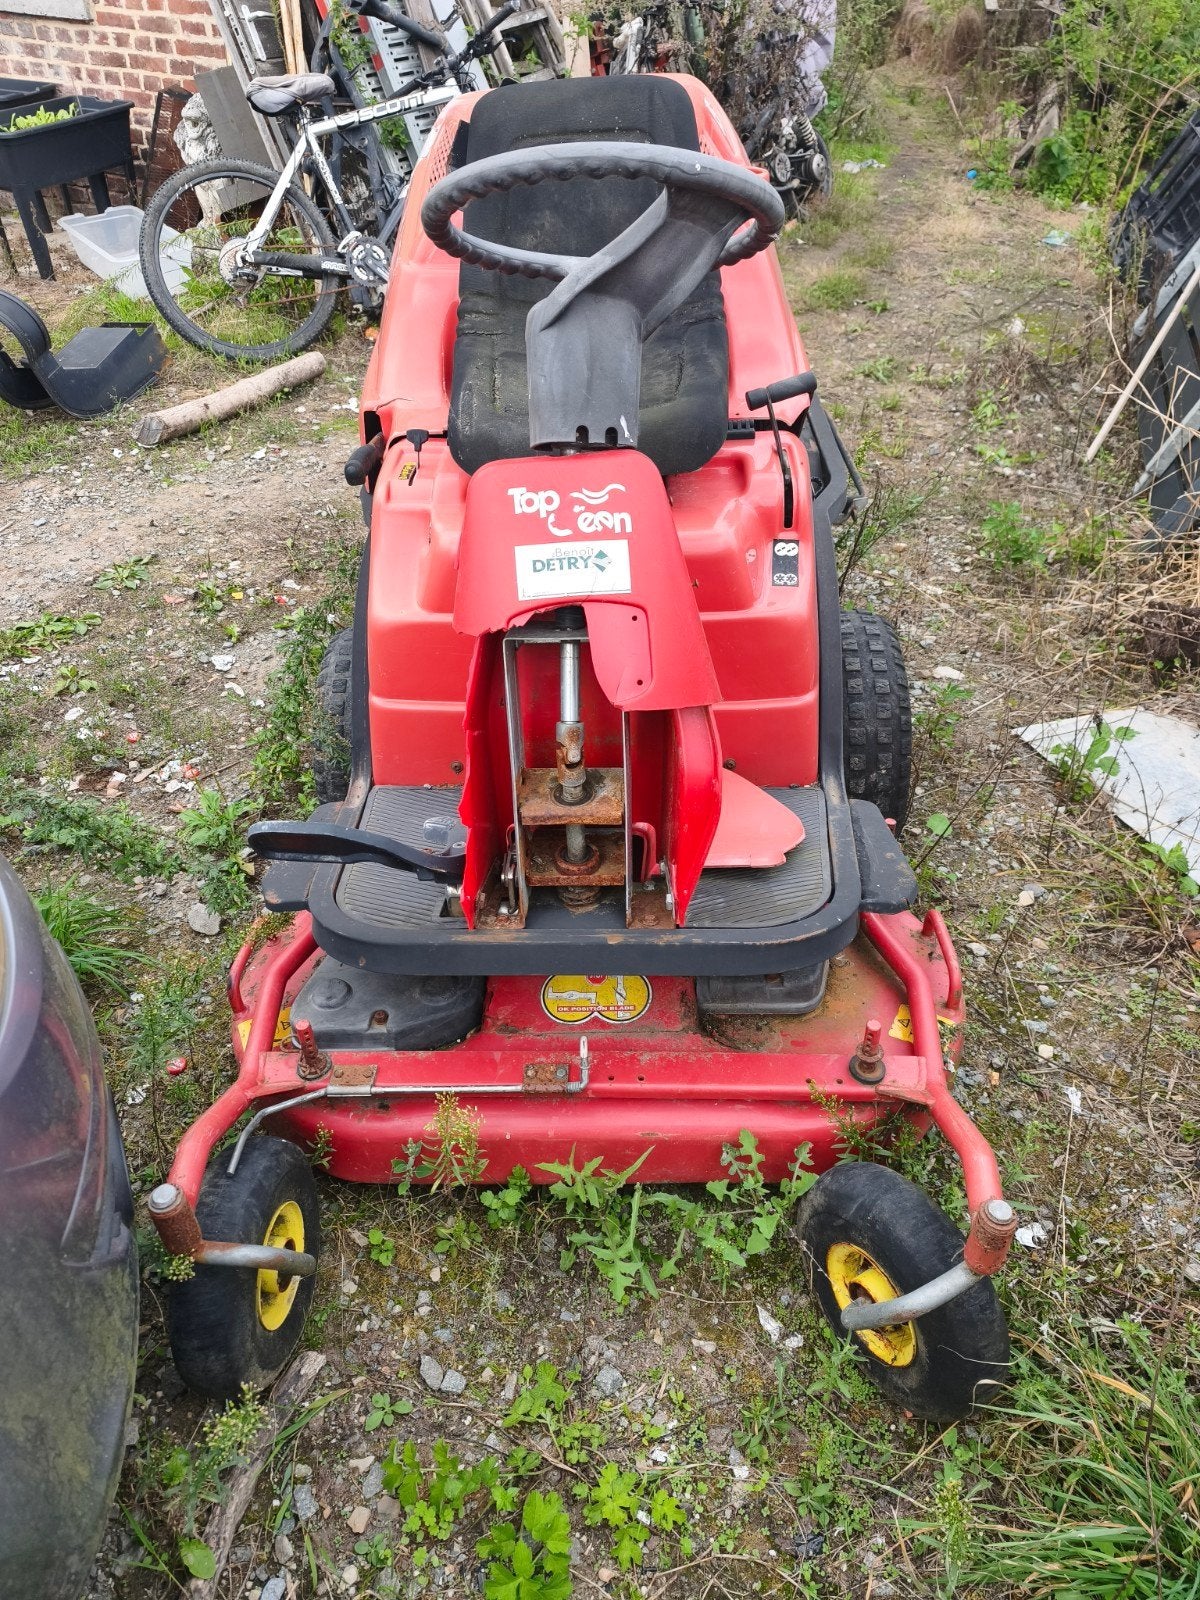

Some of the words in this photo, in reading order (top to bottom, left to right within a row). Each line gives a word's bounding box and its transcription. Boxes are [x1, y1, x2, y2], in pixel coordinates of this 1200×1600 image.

[357, 92, 427, 124] SCOTT
[507, 486, 560, 518] Top
[532, 556, 592, 573] DETRY
